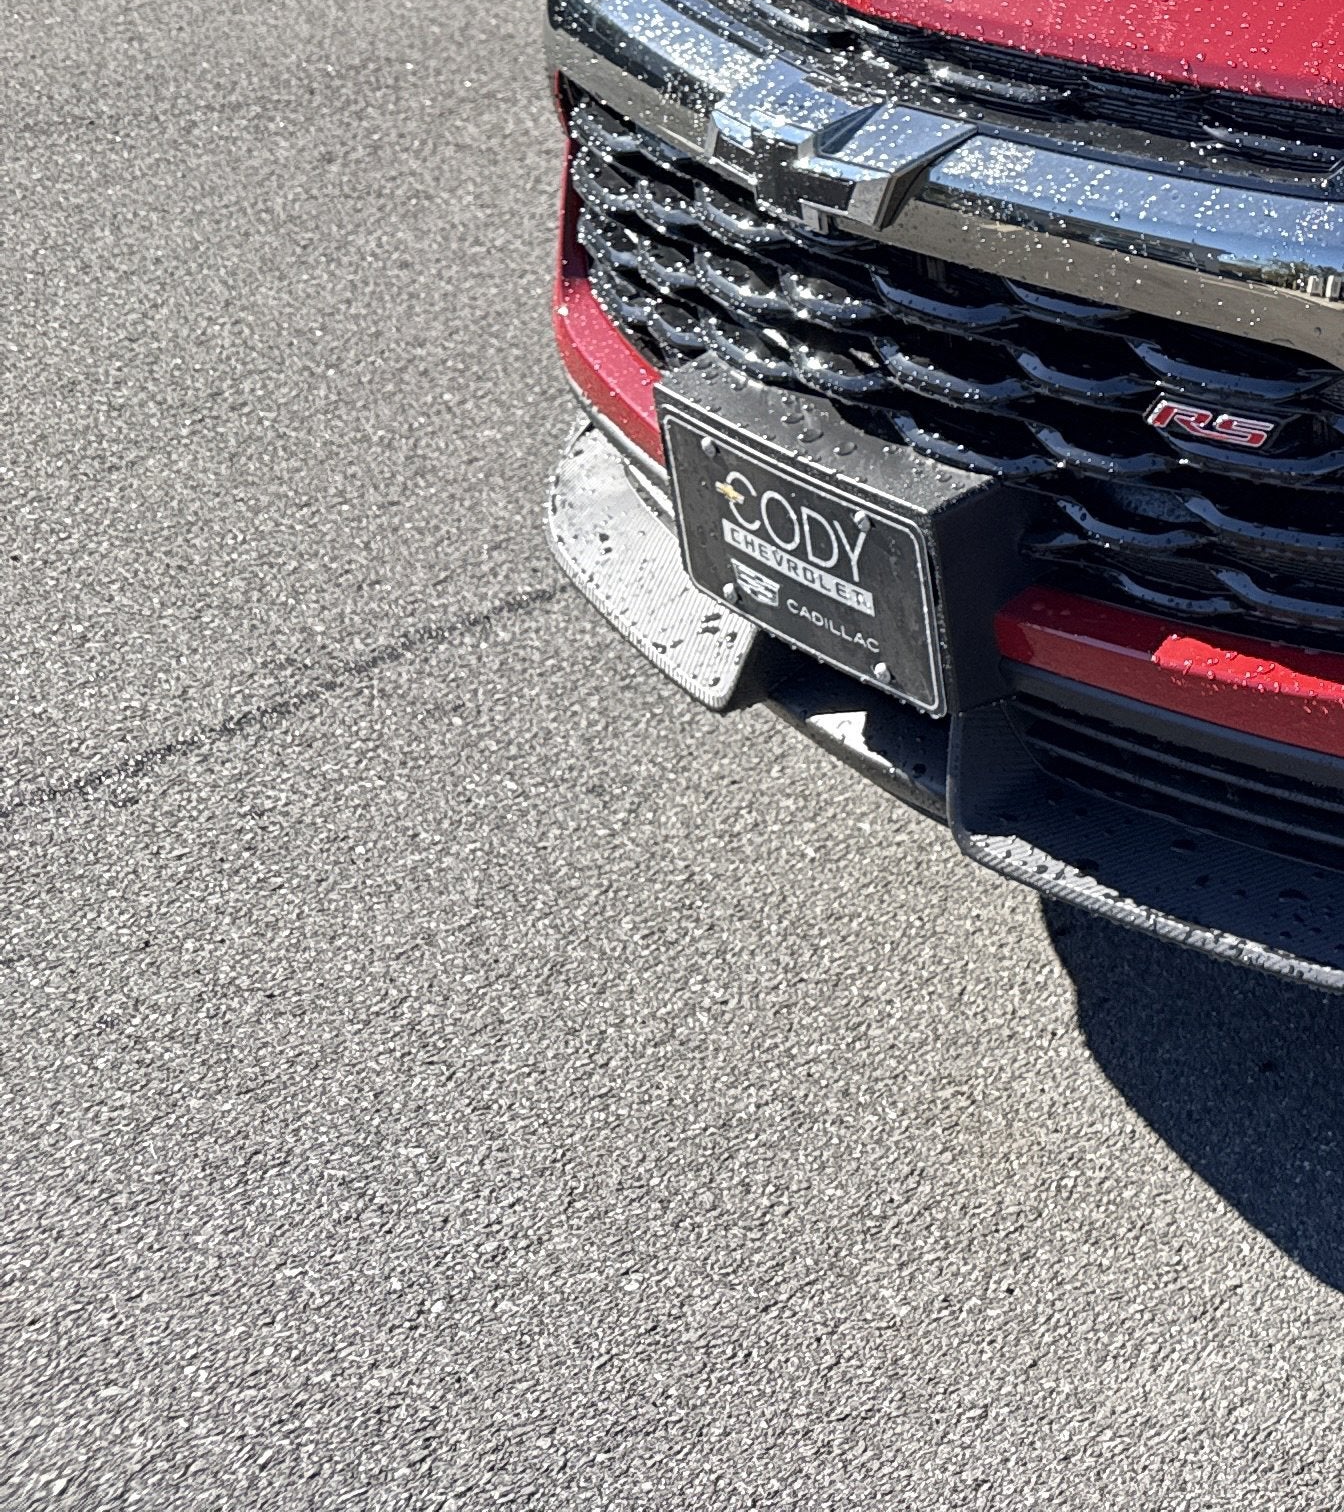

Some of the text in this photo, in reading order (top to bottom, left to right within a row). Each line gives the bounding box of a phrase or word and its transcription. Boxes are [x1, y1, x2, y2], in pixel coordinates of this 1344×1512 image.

[1147, 399, 1275, 448] RS
[724, 471, 868, 583] CODY
[729, 527, 870, 610] CHEVROLET
[786, 598, 881, 654] CADILLAC
